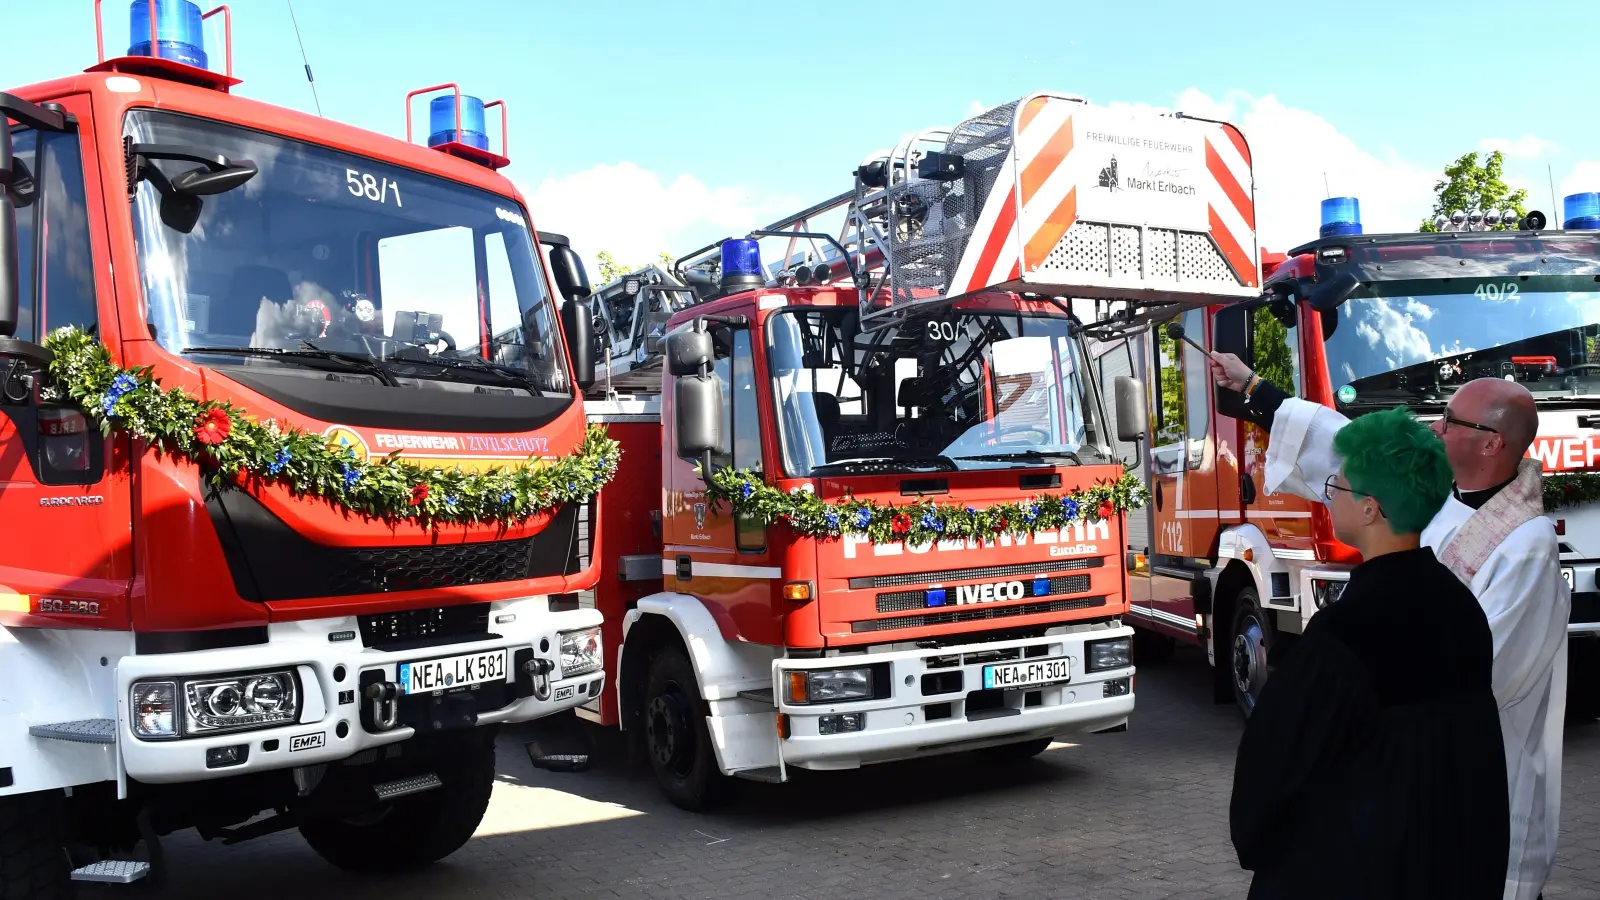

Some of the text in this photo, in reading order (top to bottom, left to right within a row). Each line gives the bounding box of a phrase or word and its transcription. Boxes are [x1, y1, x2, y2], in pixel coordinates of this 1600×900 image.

[1086, 131, 1193, 154] FREIWILLIGE FEUERWEHR
[346, 168, 402, 207] 58/1
[1127, 177, 1196, 195] Markt Erlbach
[1473, 282, 1521, 301] 40/2
[375, 433, 549, 452] FEUERWEHR ZIVILSCHUTZ
[40, 495, 104, 507] EUROCARGO
[1167, 521, 1183, 552] 112
[956, 581, 1024, 605] IVECO
[413, 653, 504, 690] NEA LK 581
[994, 660, 1067, 685] NEA FM 301
[556, 688, 572, 698] EMPL
[293, 735, 322, 749] EMPL
